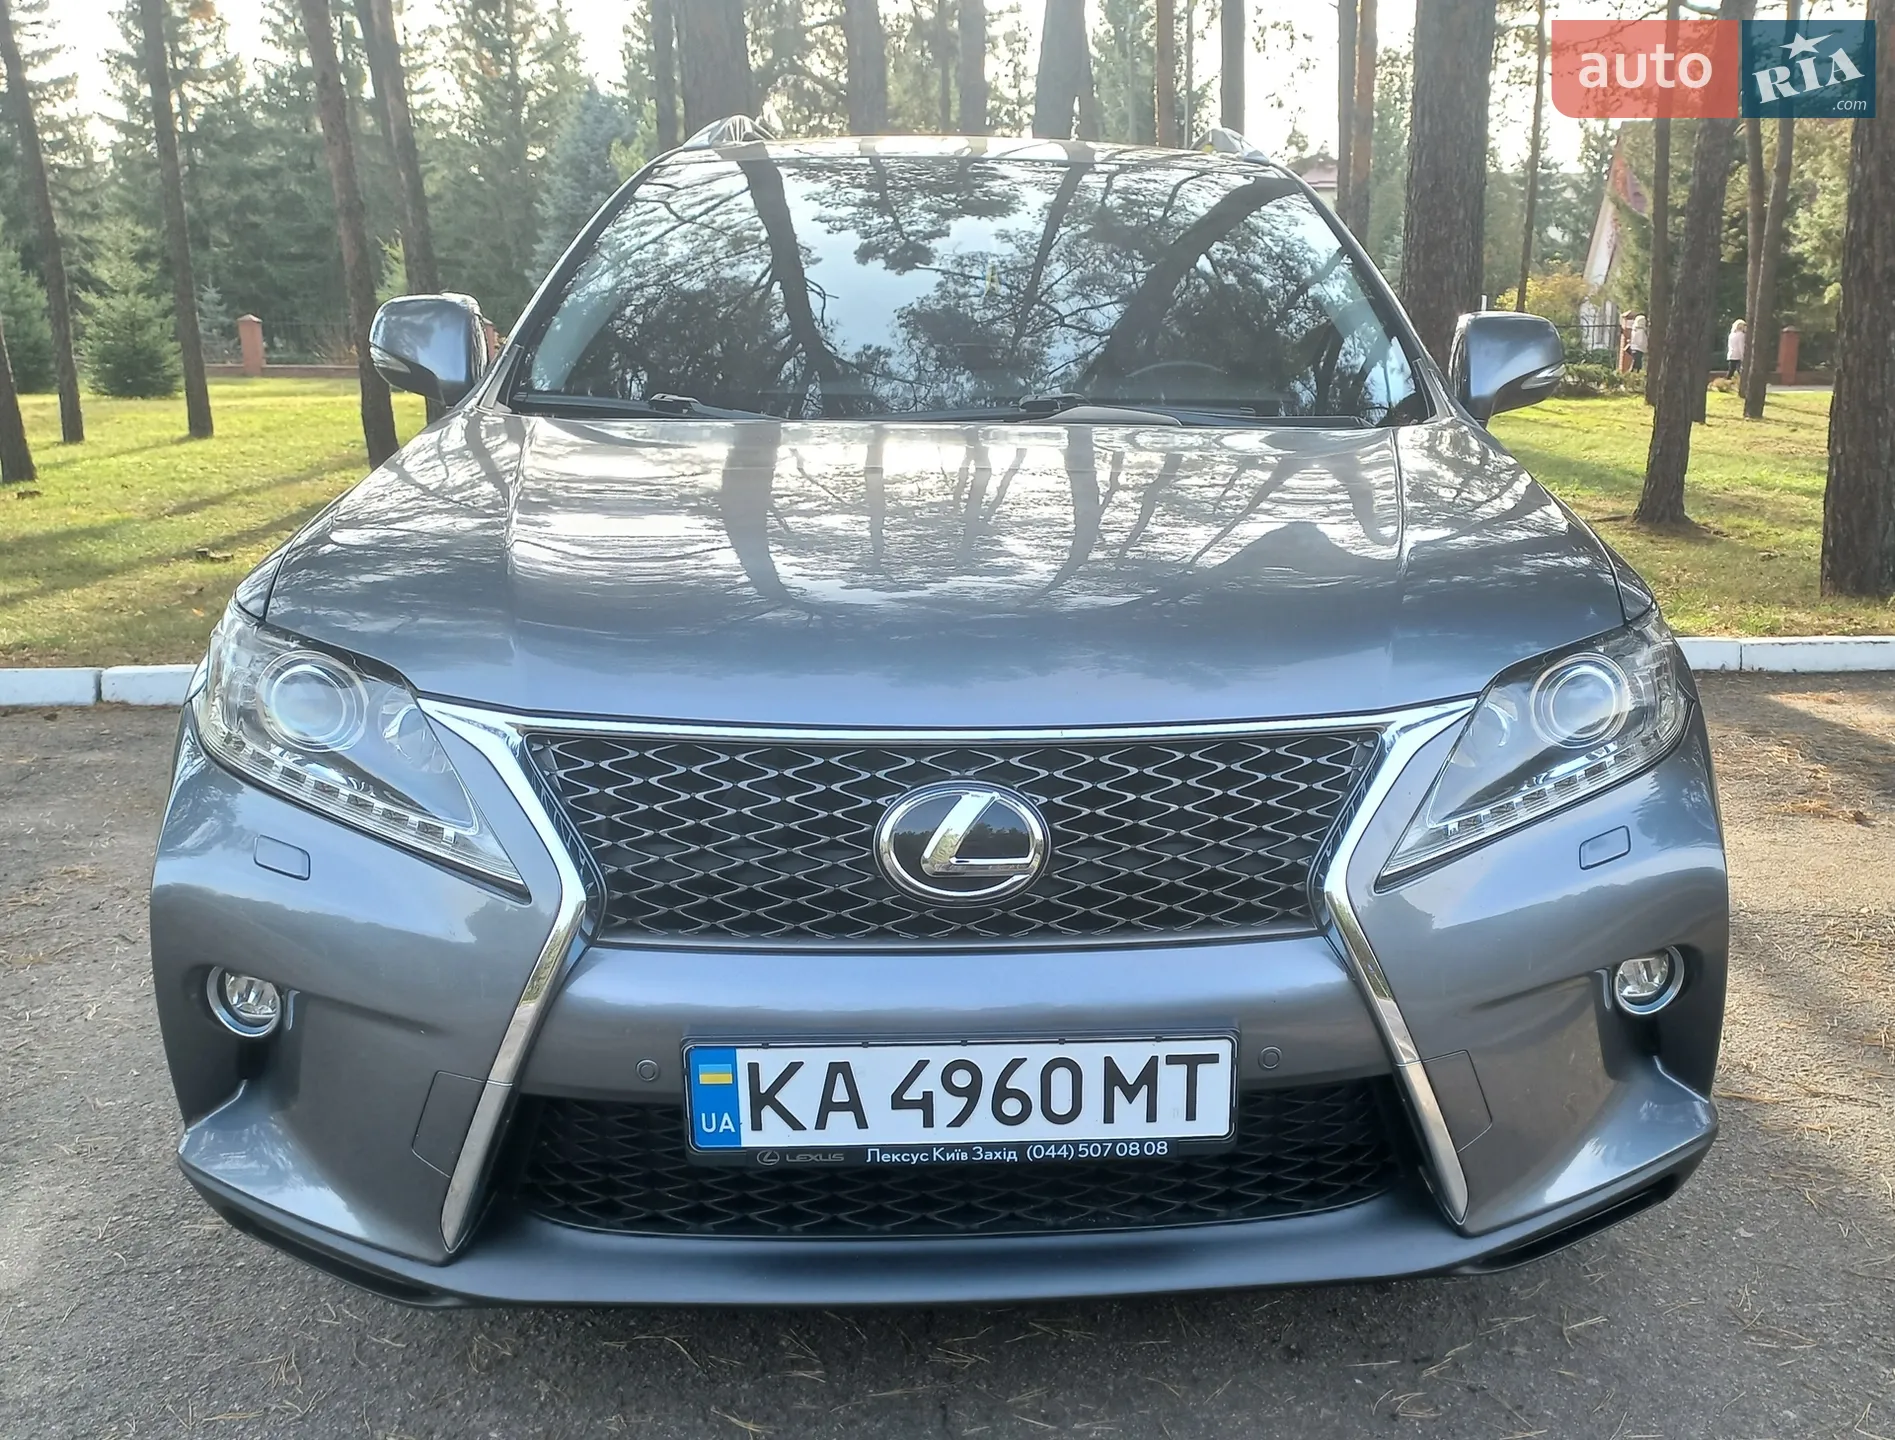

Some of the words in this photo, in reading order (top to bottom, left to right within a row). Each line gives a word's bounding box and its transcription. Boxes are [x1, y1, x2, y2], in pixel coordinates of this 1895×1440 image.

[747, 1061, 869, 1131] KA
[890, 1057, 1083, 1128] 4960
[1103, 1054, 1220, 1124] MT
[701, 1112, 736, 1133] UA
[786, 1153, 845, 1162] LEXUS
[866, 1148, 929, 1165] Лексус
[932, 1147, 969, 1162] Київ
[972, 1146, 1018, 1162] Захід
[1026, 1144, 1075, 1161] (044)
[1078, 1143, 1112, 1158] 507
[1115, 1142, 1140, 1157] 08
[1143, 1141, 1168, 1156] 08
